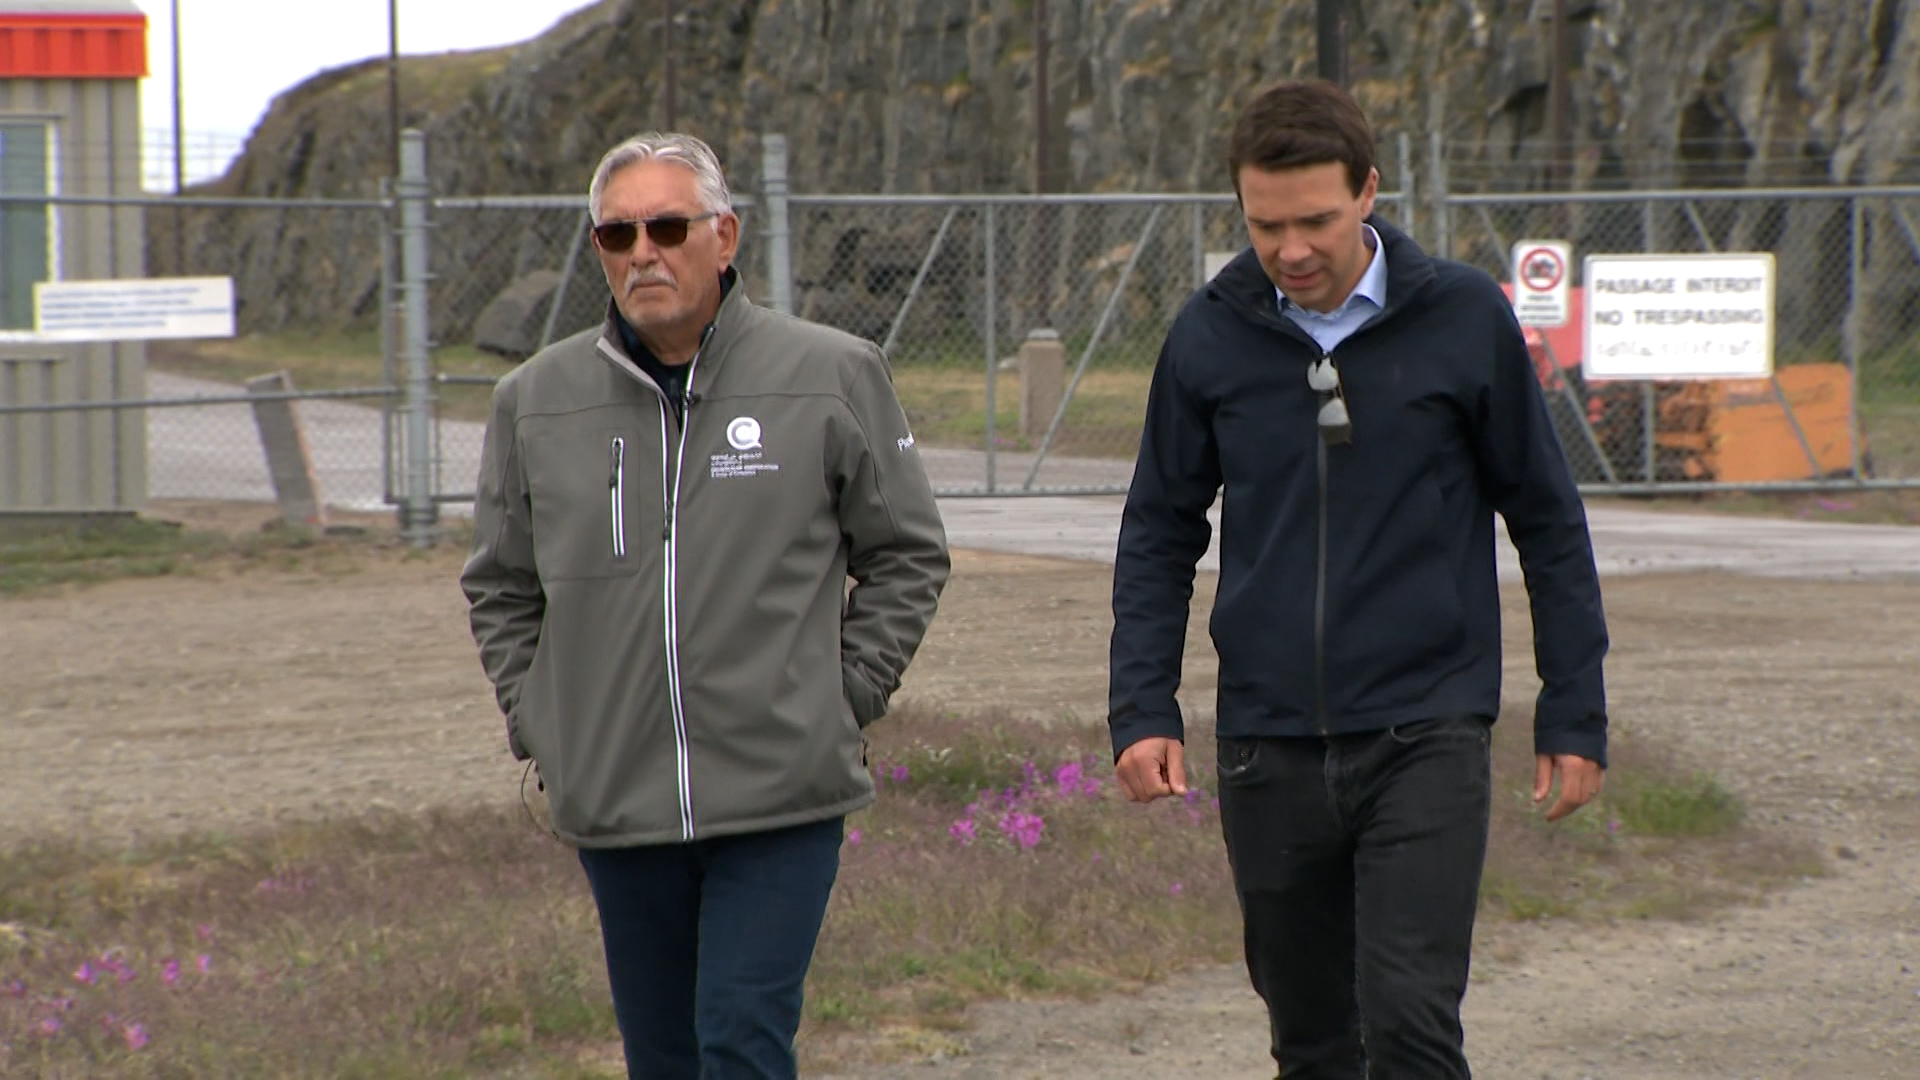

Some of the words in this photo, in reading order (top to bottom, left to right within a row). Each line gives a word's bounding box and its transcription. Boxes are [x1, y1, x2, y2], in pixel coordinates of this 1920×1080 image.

[1595, 278, 1676, 294] PASSAGE
[1686, 277, 1763, 293] INTERDIT
[1594, 310, 1623, 325] NO
[1633, 309, 1763, 325] TRESPASSING
